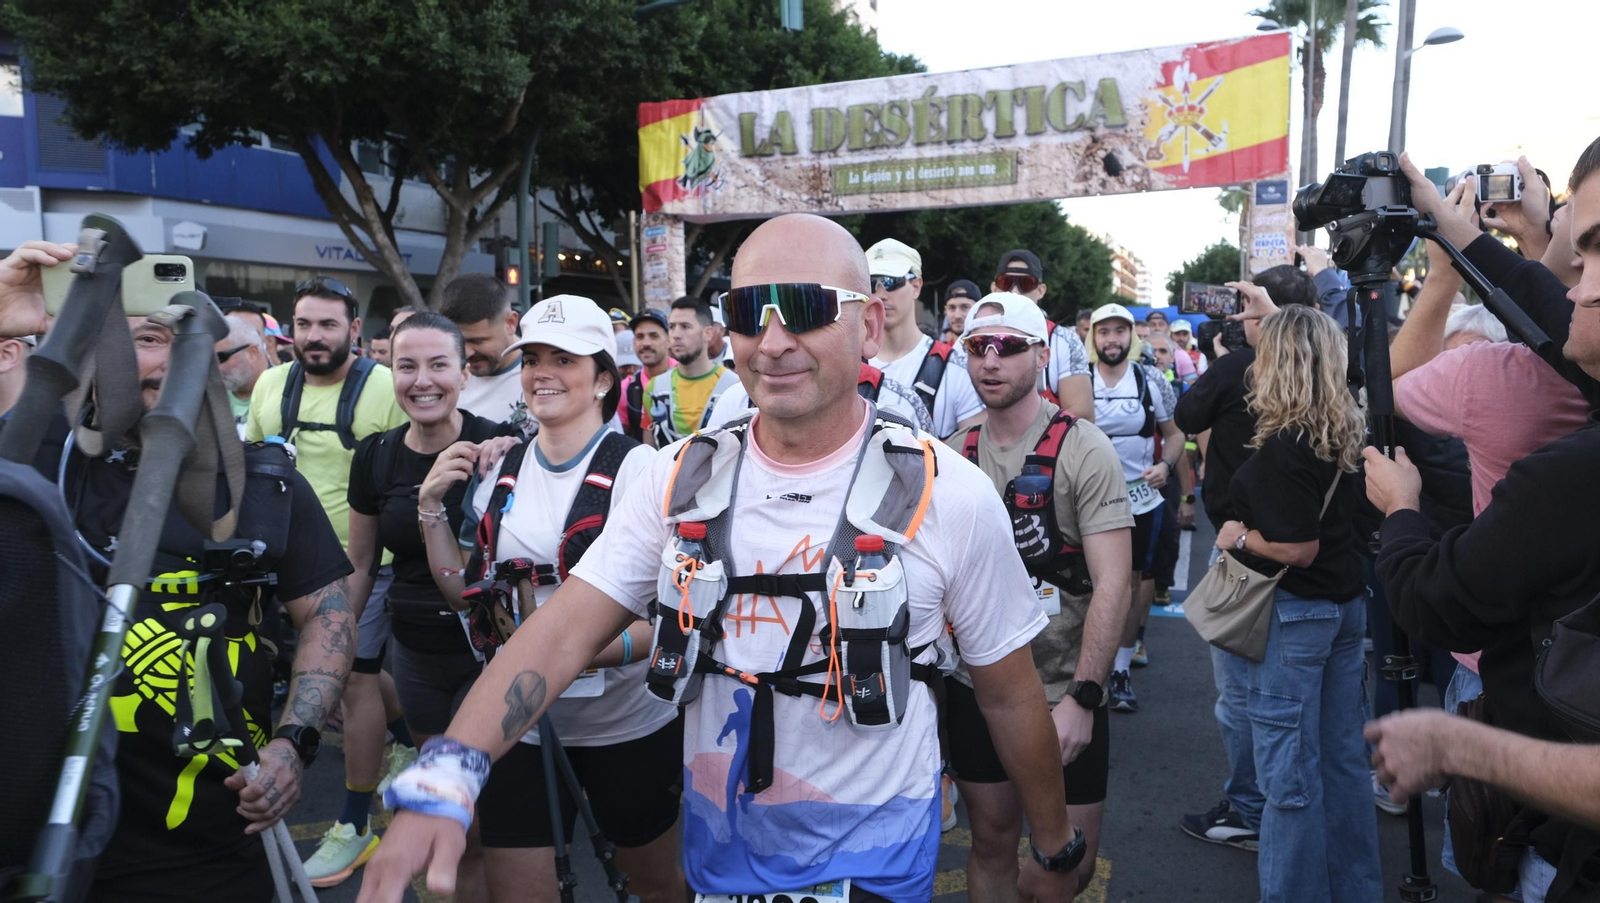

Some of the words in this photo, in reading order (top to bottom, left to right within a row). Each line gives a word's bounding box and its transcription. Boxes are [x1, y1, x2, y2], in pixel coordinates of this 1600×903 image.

[738, 110, 798, 157] LA
[811, 77, 1128, 154] DESÉRTICA
[862, 169, 892, 184] Legión
[895, 171, 902, 184] y
[905, 167, 915, 180] el
[918, 165, 955, 179] desierto
[958, 165, 975, 176] nos
[979, 164, 997, 175] une
[315, 244, 413, 267] VITALT
[537, 300, 566, 324] A
